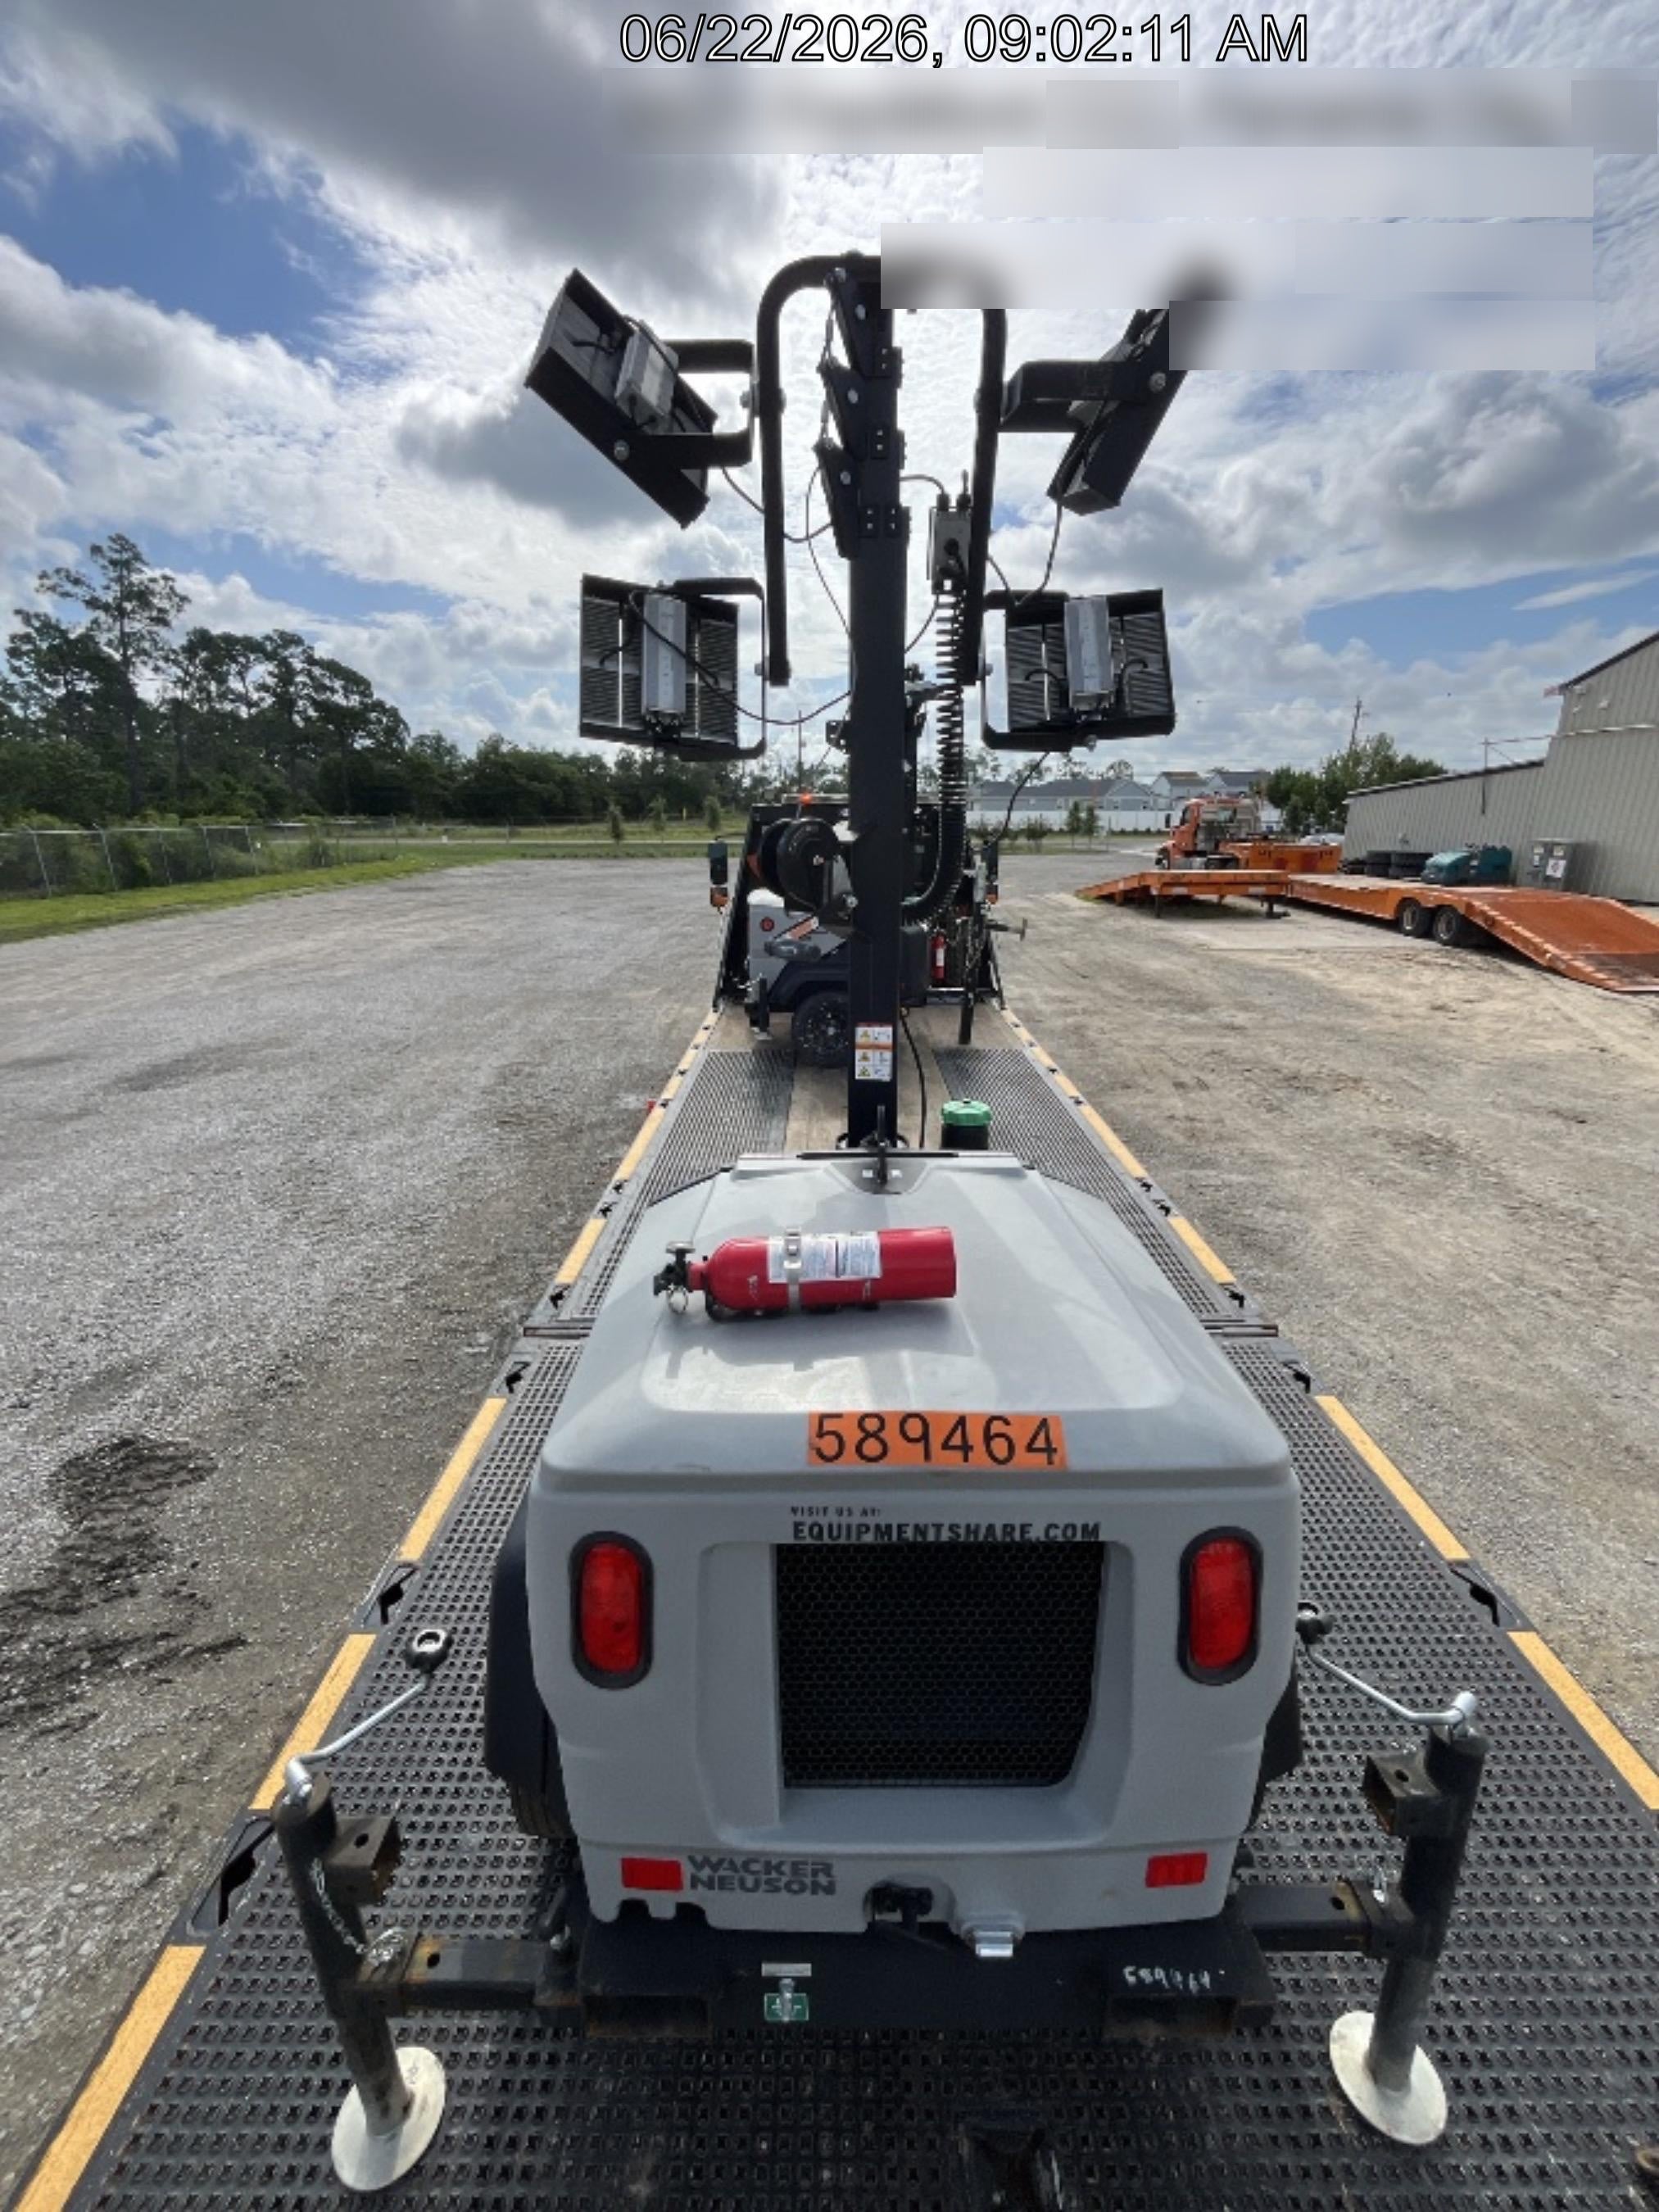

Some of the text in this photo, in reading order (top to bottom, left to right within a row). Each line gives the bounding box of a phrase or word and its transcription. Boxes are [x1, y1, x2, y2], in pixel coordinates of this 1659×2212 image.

[815, 1412, 1058, 1466] 589464
[791, 1506, 829, 1517] VISIT
[836, 1507, 853, 1517] US
[792, 1520, 1100, 1543] EQUIPMENTSHARE.COM
[687, 1855, 834, 1879] WACKER
[690, 1872, 836, 1896] NEUSON
